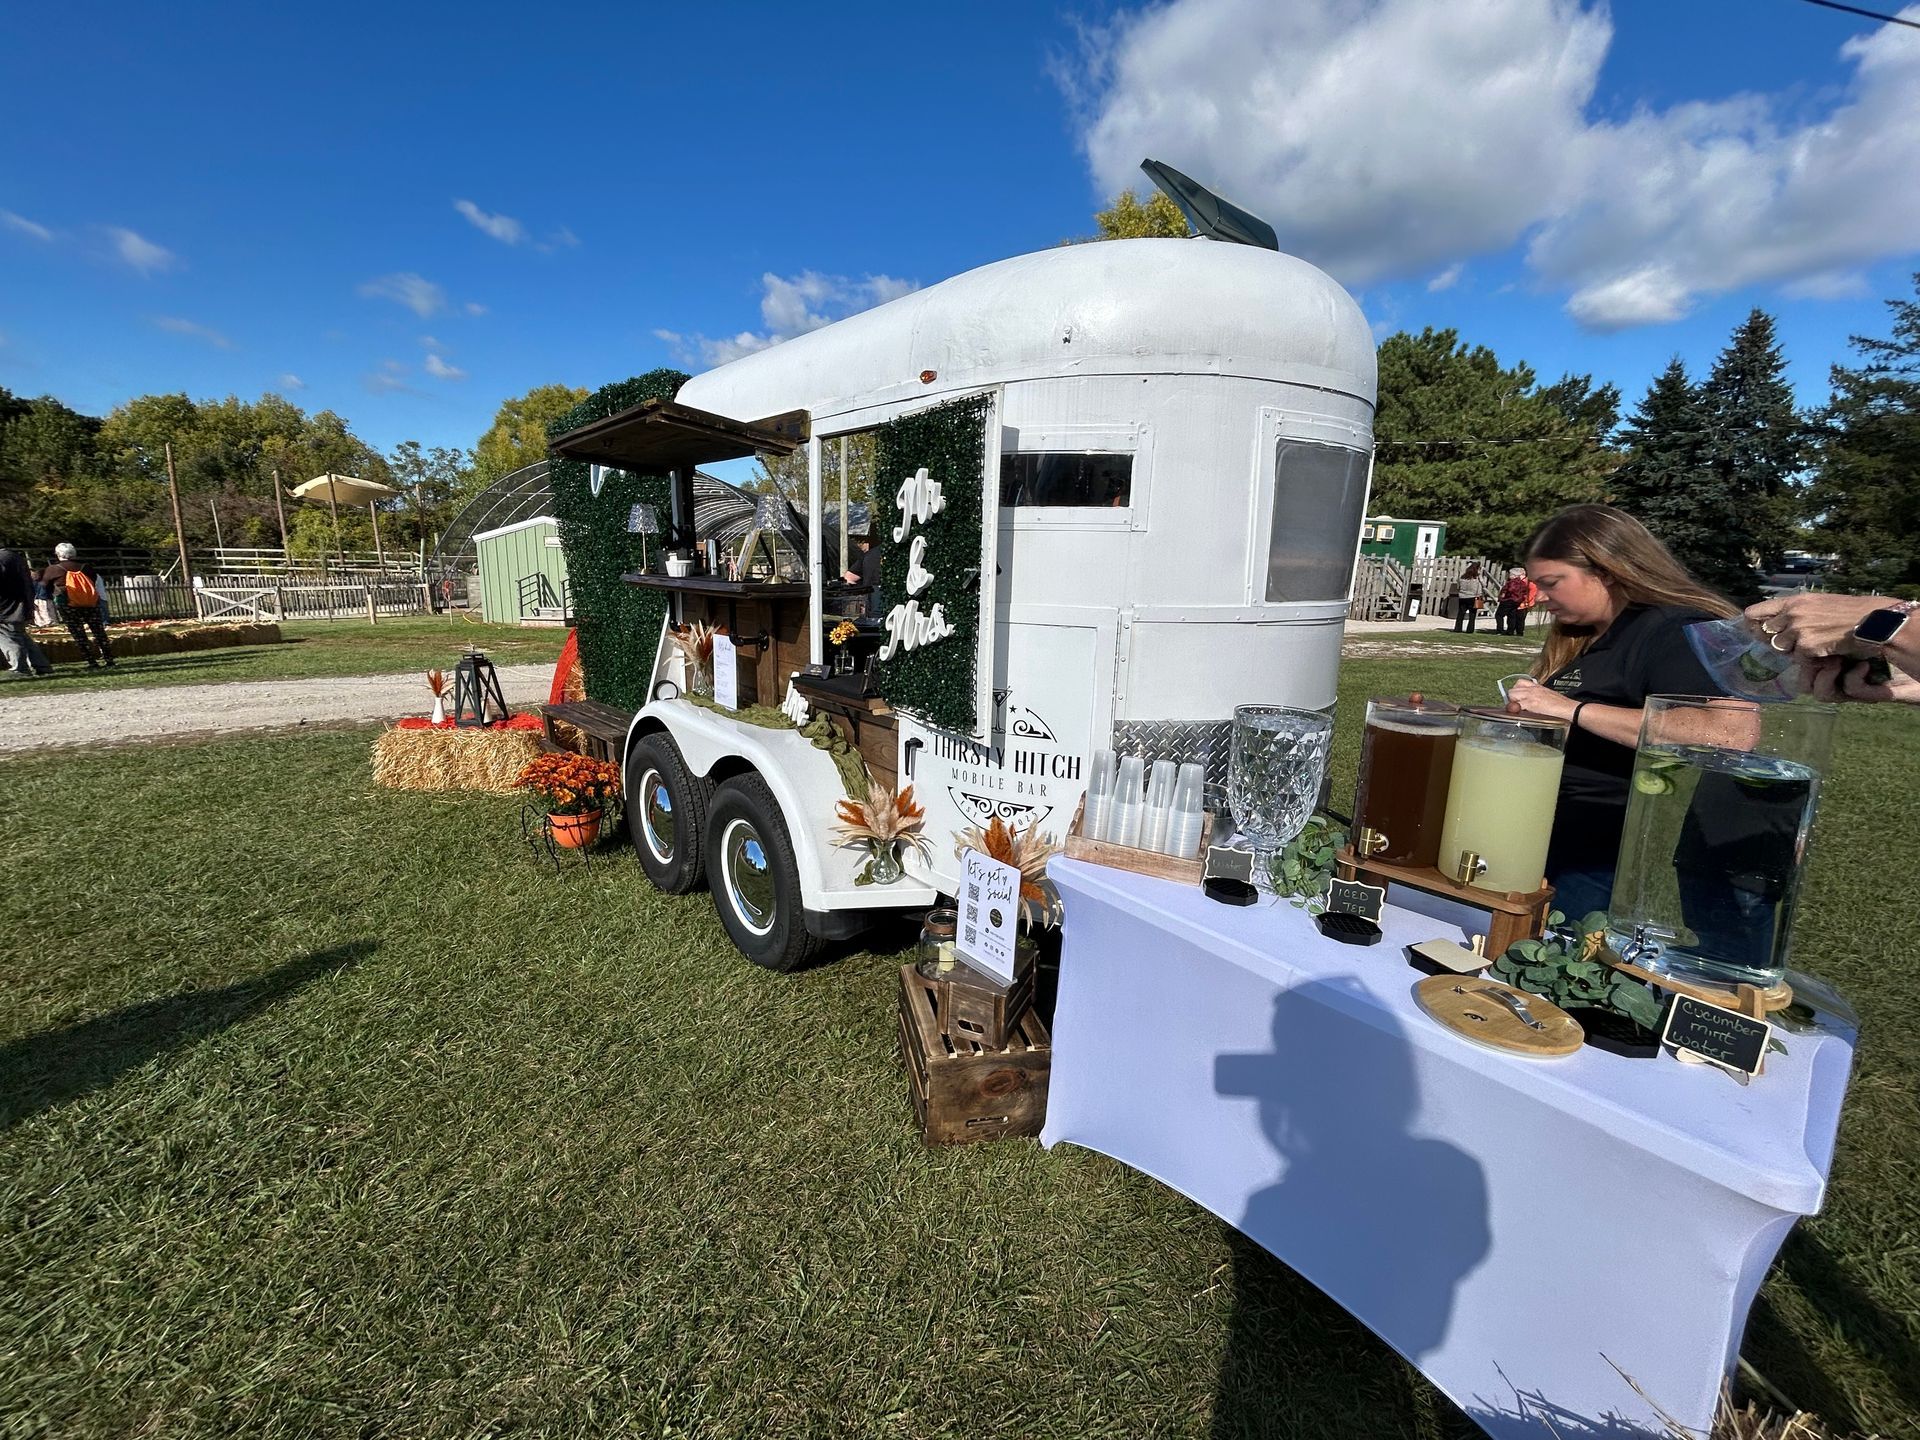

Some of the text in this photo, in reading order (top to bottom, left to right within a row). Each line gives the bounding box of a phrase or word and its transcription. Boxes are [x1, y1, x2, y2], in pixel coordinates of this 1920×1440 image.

[906, 536, 934, 595] &
[933, 734, 1081, 780] THIRSTY HITCH
[951, 767, 1047, 797] MOBILE BAR
[987, 867, 1005, 886] get
[987, 886, 1013, 904] social
[1338, 887, 1369, 901] ICED
[1672, 1031, 1735, 1060] water
[1690, 1022, 1736, 1045] mint
